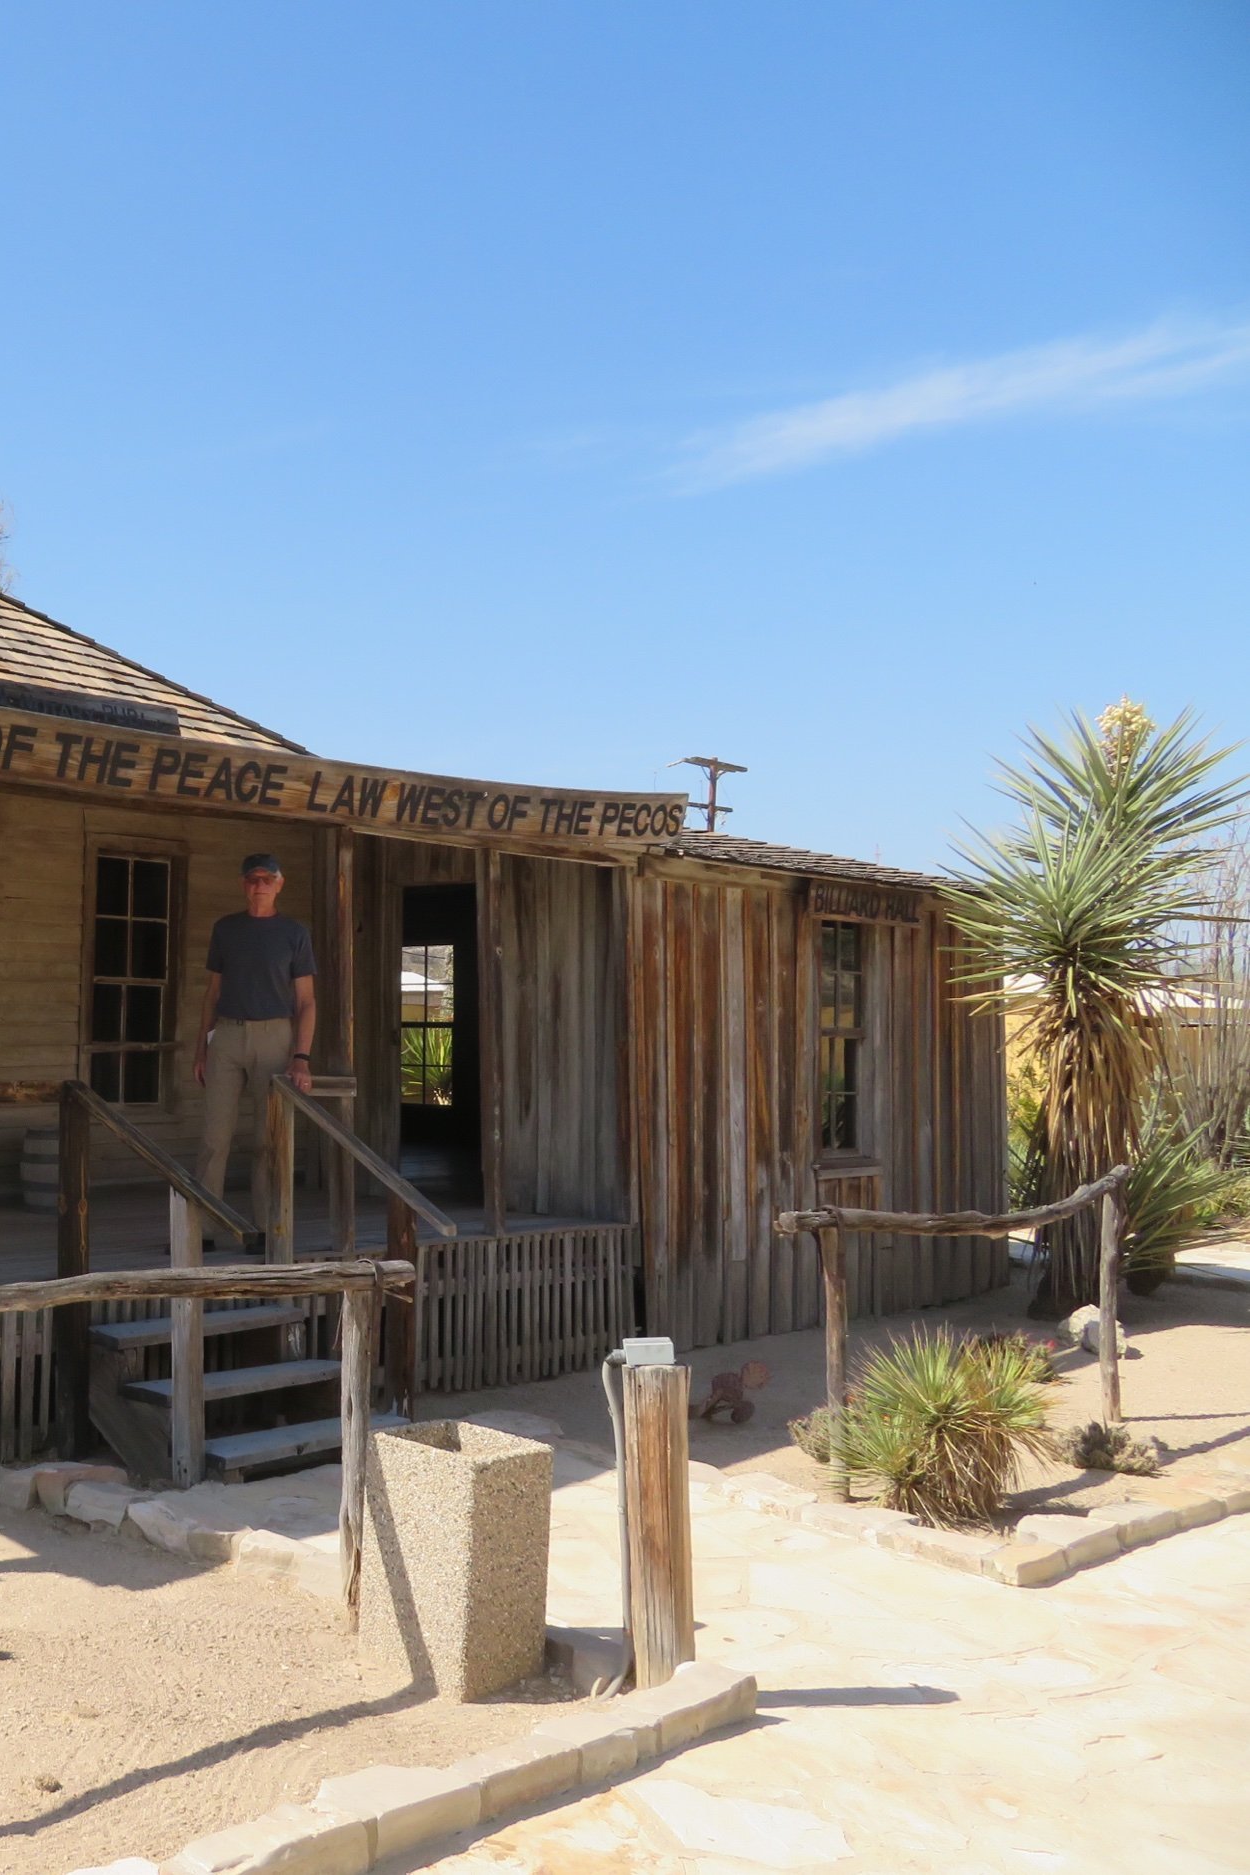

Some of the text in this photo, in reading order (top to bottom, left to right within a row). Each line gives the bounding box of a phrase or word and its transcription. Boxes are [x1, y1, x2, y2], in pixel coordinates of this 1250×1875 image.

[55, 732, 140, 787] THE
[149, 747, 288, 806] PEACE
[306, 771, 388, 818] LAW
[395, 782, 486, 829] WEST
[486, 793, 529, 832] OF
[538, 798, 596, 835] THE
[597, 802, 684, 837] PECOS
[815, 884, 919, 923] BILLIARD HALL
